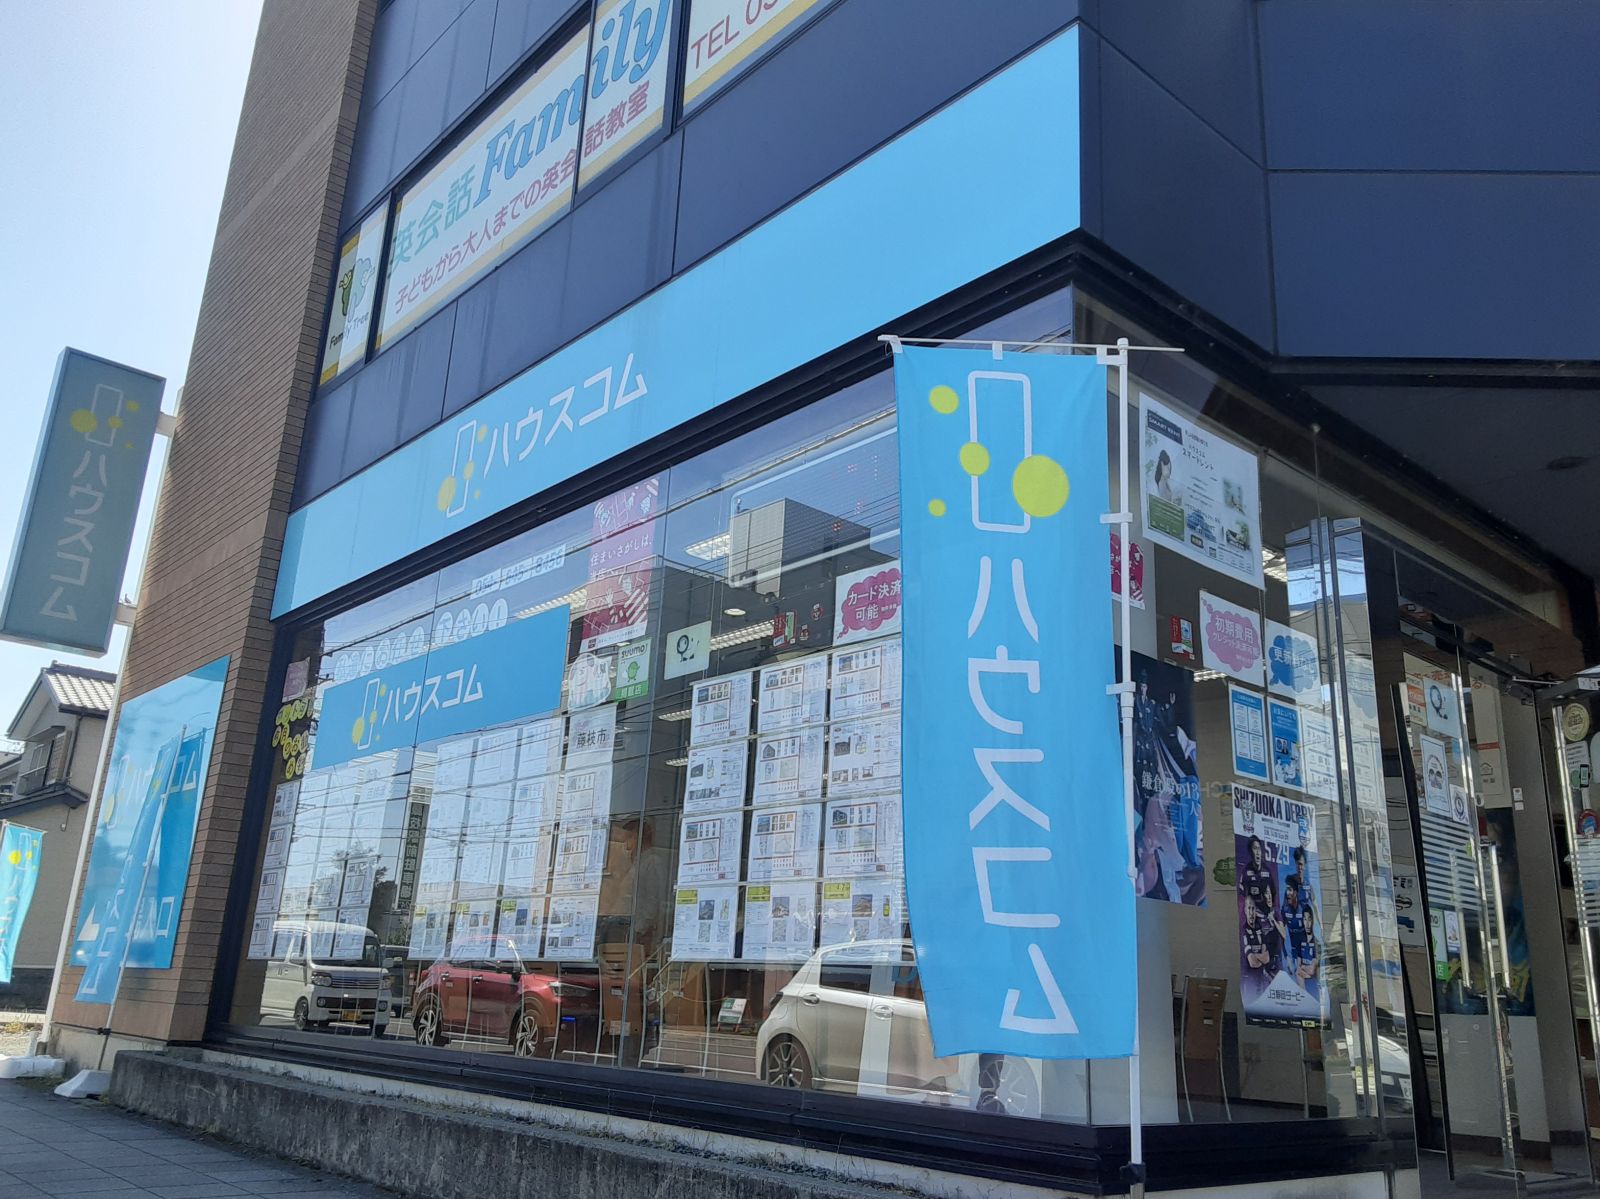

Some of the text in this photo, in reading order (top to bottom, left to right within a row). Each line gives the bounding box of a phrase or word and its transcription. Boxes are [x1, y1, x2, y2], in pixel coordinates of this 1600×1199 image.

[690, 14, 740, 69] TEL
[472, 0, 671, 209] Family
[394, 80, 650, 315] 子どもから大人までの英会話教室
[483, 352, 648, 478] ハウスコム
[40, 449, 108, 622] ハウスコム
[855, 604, 879, 621] 可能
[1215, 615, 1254, 643] 初期費用
[381, 663, 484, 725] ハウスコム
[576, 728, 607, 748] 藤枝市
[1233, 786, 1283, 821] SHIZUOKA
[1264, 840, 1290, 866] 5.29
